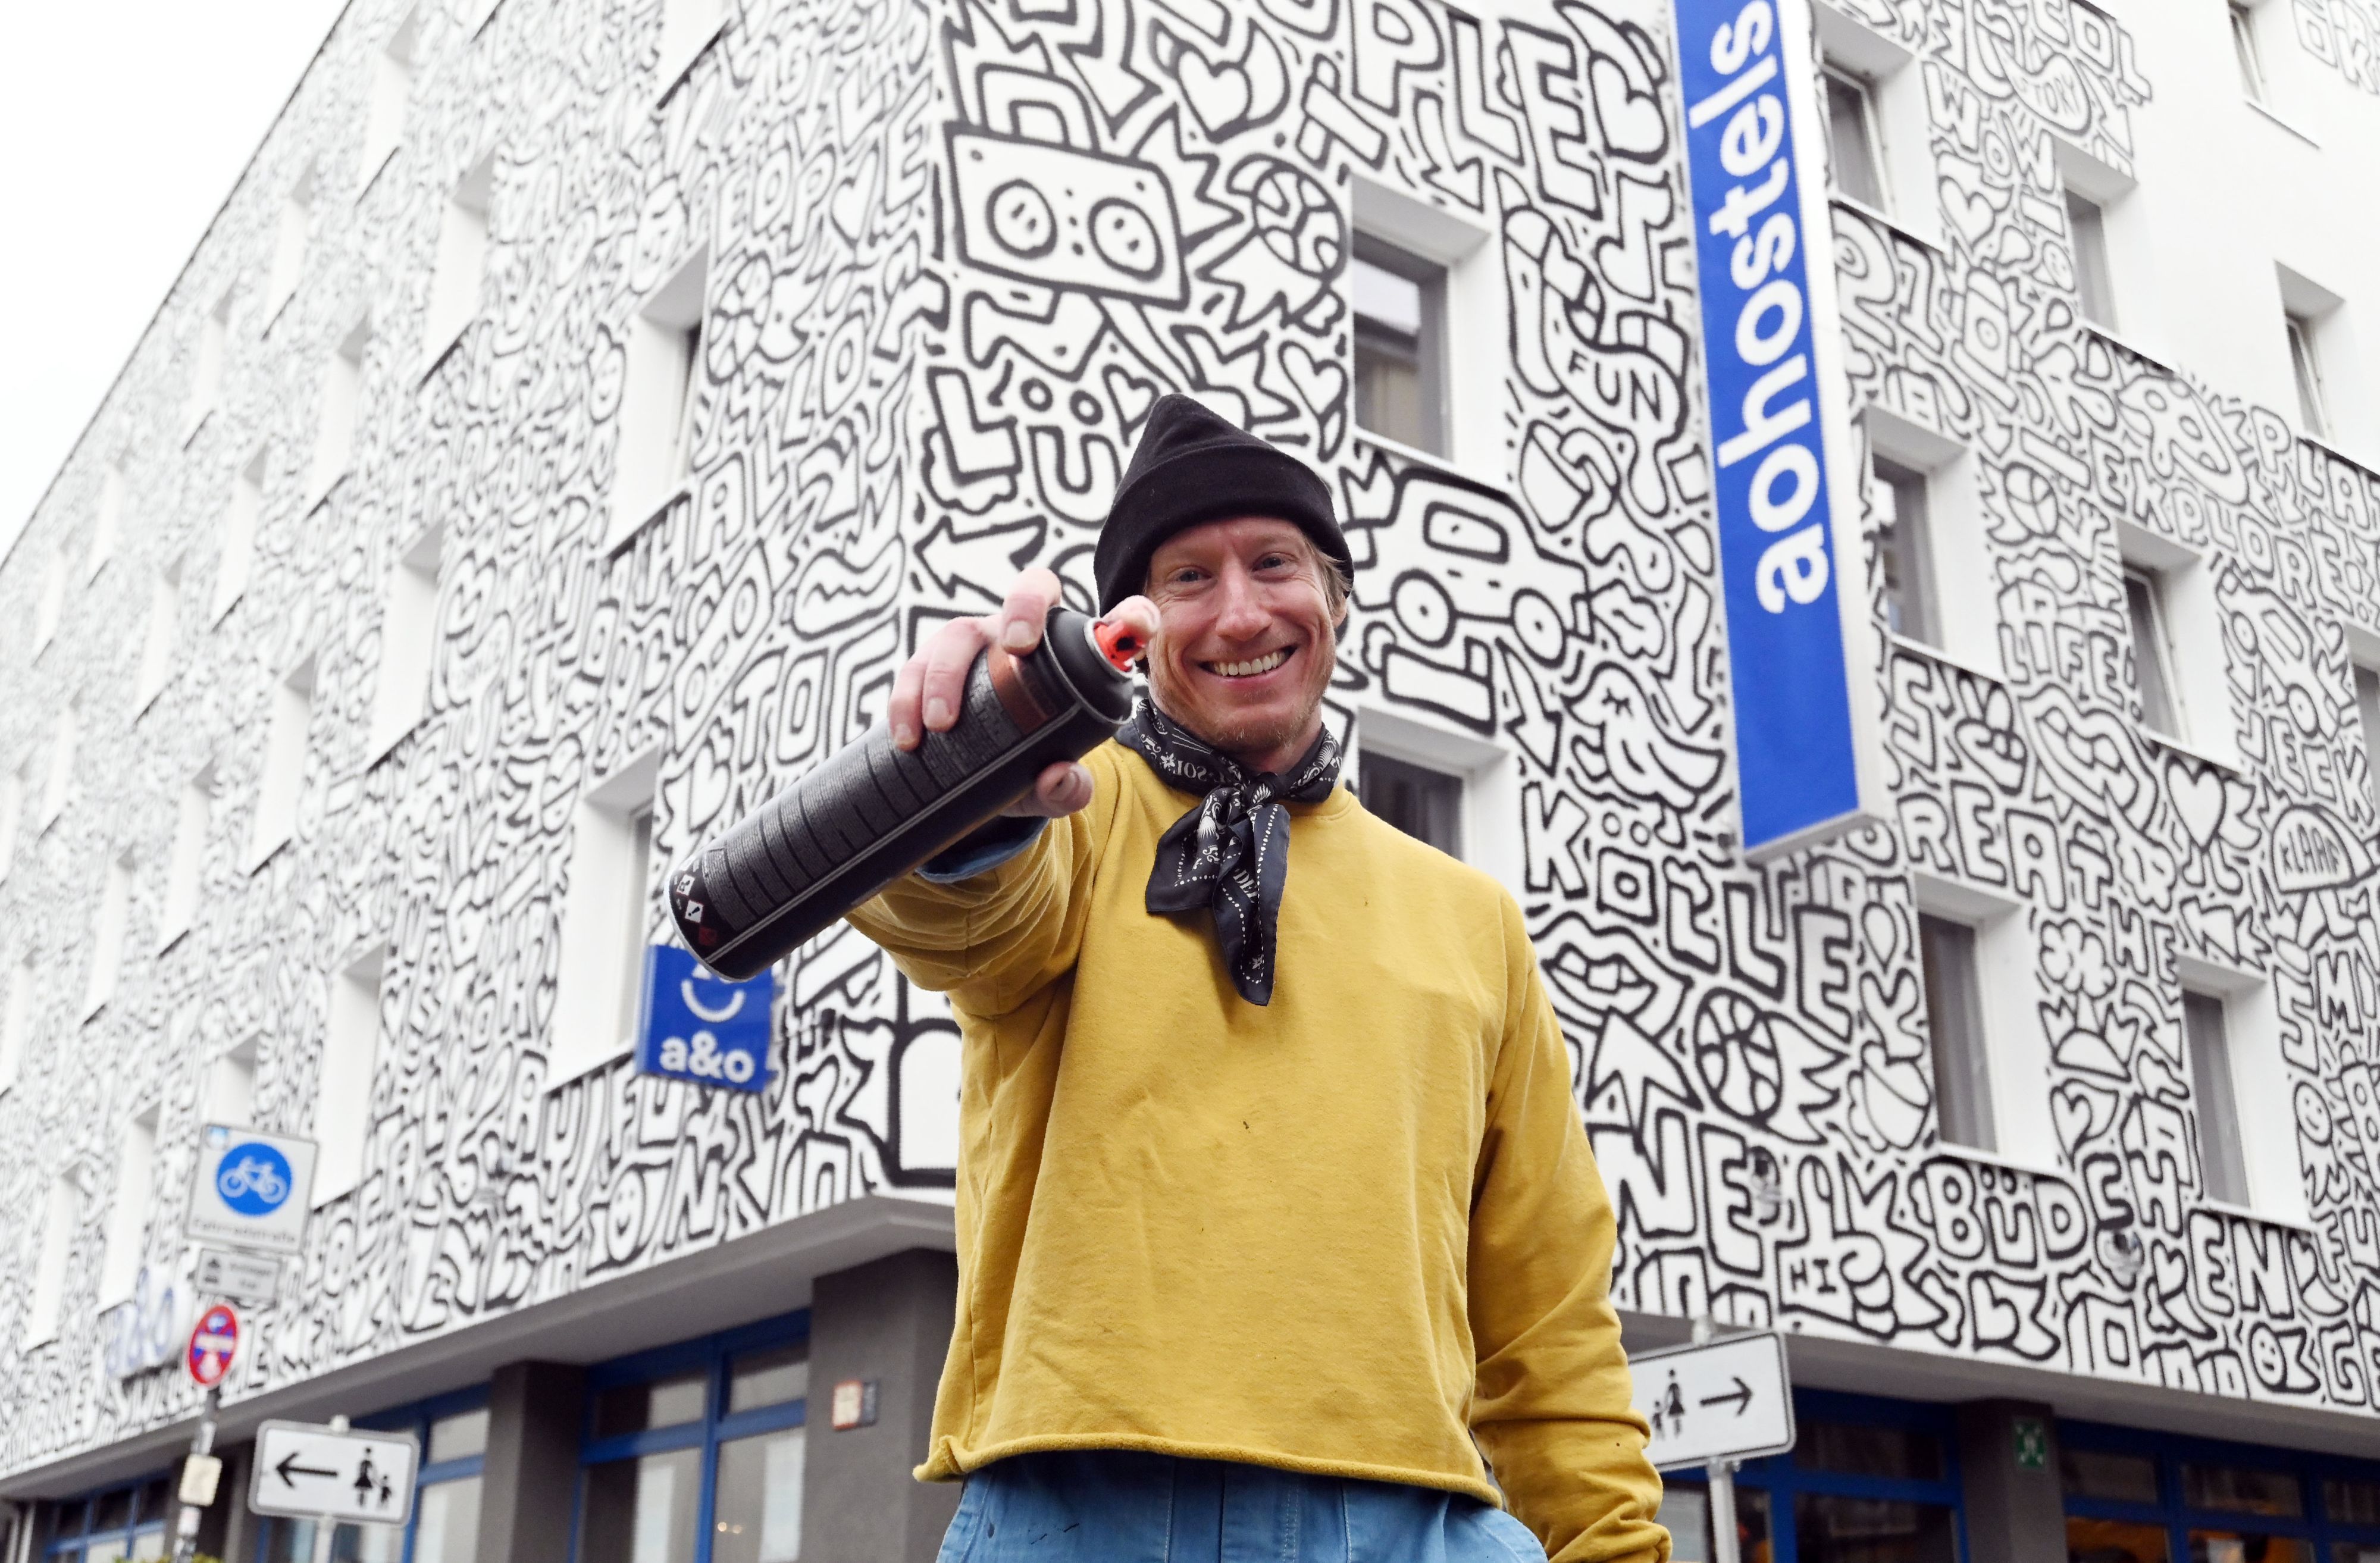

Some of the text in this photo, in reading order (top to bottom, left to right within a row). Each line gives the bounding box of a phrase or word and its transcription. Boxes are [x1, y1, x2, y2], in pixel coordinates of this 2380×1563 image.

[1568, 350, 1662, 421] FUN
[1521, 781, 1854, 1045] KÖLLE
[659, 1030, 754, 1083] a&o
[1790, 1257, 1839, 1295] HI
